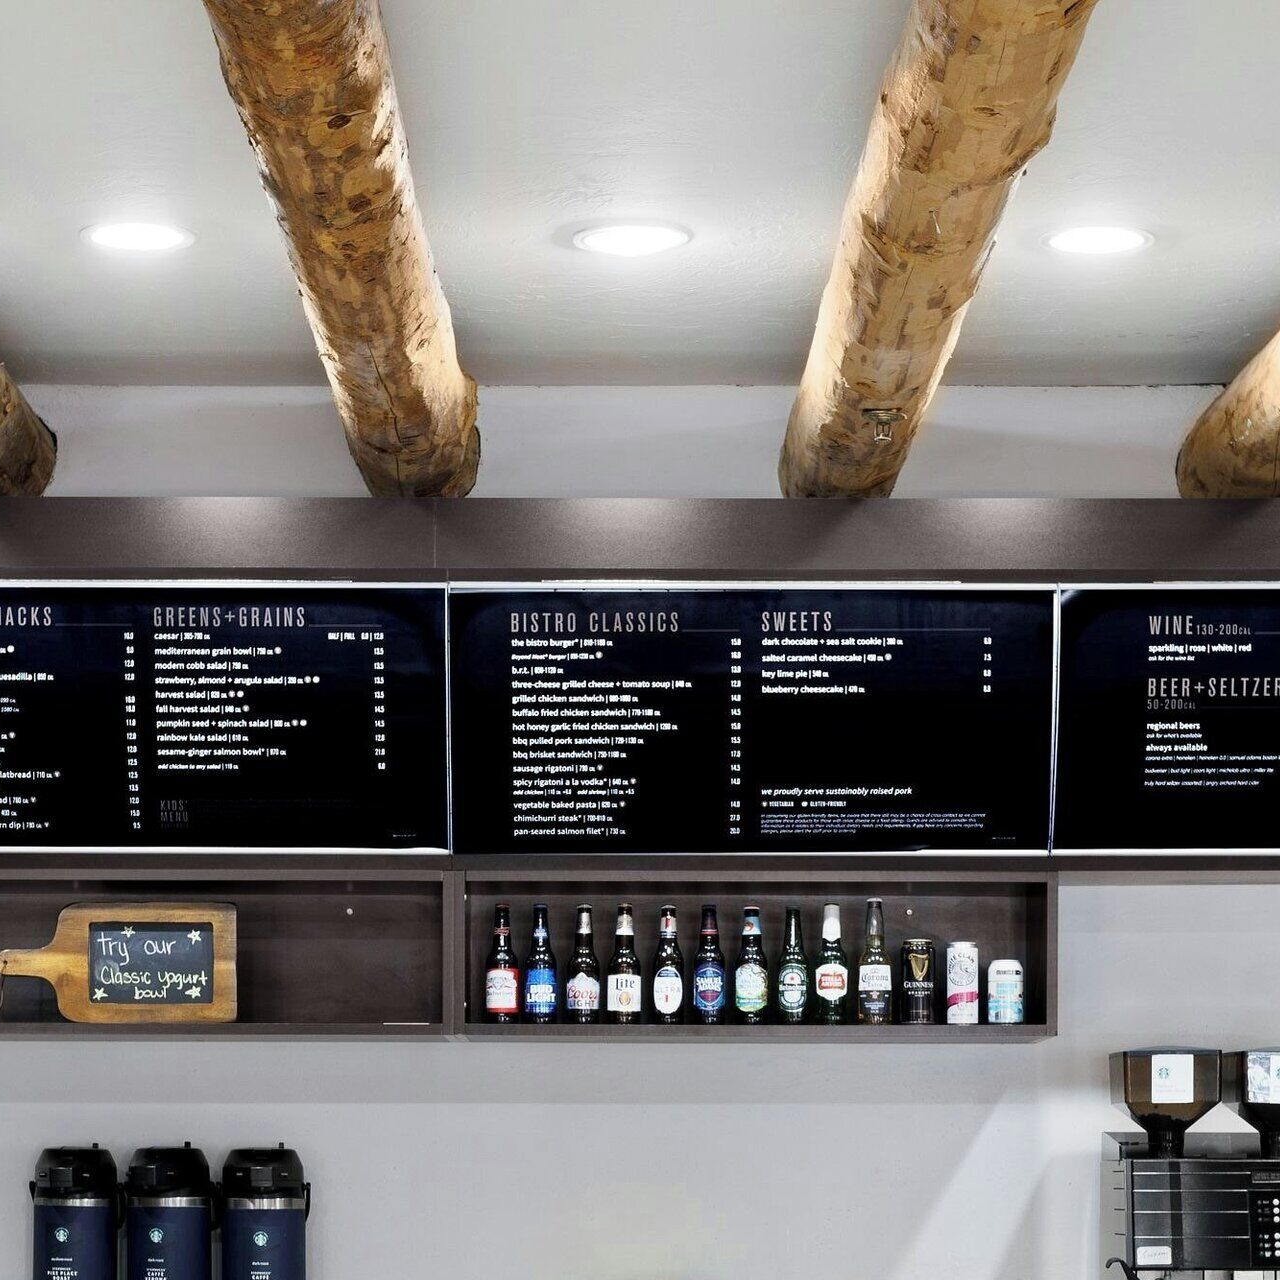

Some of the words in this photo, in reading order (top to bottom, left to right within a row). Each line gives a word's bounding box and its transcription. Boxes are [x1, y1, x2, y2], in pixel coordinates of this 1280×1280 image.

[511, 613, 576, 632] BISTRO
[590, 612, 678, 632] CLASSICS
[762, 611, 831, 631] SWEETS
[1149, 616, 1193, 634] WINE
[154, 646, 211, 656] mediterranean
[211, 646, 232, 658] grain
[232, 646, 253, 656] bowl
[154, 660, 185, 670] modern
[185, 661, 206, 670] cobb
[206, 660, 228, 670] salad
[761, 669, 777, 680] key
[776, 669, 795, 678] lime
[794, 669, 808, 680] pie
[761, 684, 800, 695] blueberry
[799, 684, 845, 694] cheesecake
[512, 722, 526, 731] hot
[526, 722, 550, 733] honey
[550, 722, 572, 733] garlic
[571, 722, 590, 731] fried
[590, 722, 620, 731] chicken
[619, 722, 654, 732] sandwich
[1146, 721, 1178, 732] regional
[1178, 721, 1201, 730] beers
[156, 733, 189, 742] rainbow
[188, 733, 206, 742] kale
[206, 733, 228, 742] salad
[512, 736, 528, 747] bbq
[528, 736, 554, 747] pulled
[554, 736, 573, 746] pork
[573, 736, 611, 745] sandwich
[156, 747, 213, 758] sesame-ginger
[212, 747, 242, 756] salmon
[1145, 743, 1173, 753] always
[1173, 743, 1208, 752] available
[512, 750, 529, 760] bbq
[529, 750, 556, 759] brisket
[556, 750, 593, 759] sandwich
[512, 765, 544, 775] sausage
[544, 764, 575, 774] rigatoni
[760, 788, 773, 796] we
[772, 787, 804, 797] proudly
[803, 788, 825, 796] serve
[825, 786, 870, 797] sustainably
[869, 786, 895, 795] raised
[892, 786, 913, 796] pork
[513, 800, 550, 811] vegetable
[550, 800, 575, 809] baked
[575, 801, 597, 810] pasta
[513, 814, 557, 822] chimichurri
[8, 821, 22, 830] dip
[513, 827, 556, 837] pan-seared
[557, 827, 585, 835] salmon
[144, 939, 177, 956] our
[100, 965, 152, 985] Classic
[158, 969, 208, 991] yogurt
[695, 976, 723, 987] SAMUEL
[529, 984, 554, 993] BUD
[615, 978, 636, 991] Lite
[697, 983, 722, 993] ADAMS
[903, 980, 935, 990] GUINNESS
[133, 985, 168, 1000] bowl
[568, 984, 599, 1000] Coors
[526, 993, 557, 1003] LIGHT
[568, 1000, 596, 1008] LIGHT
